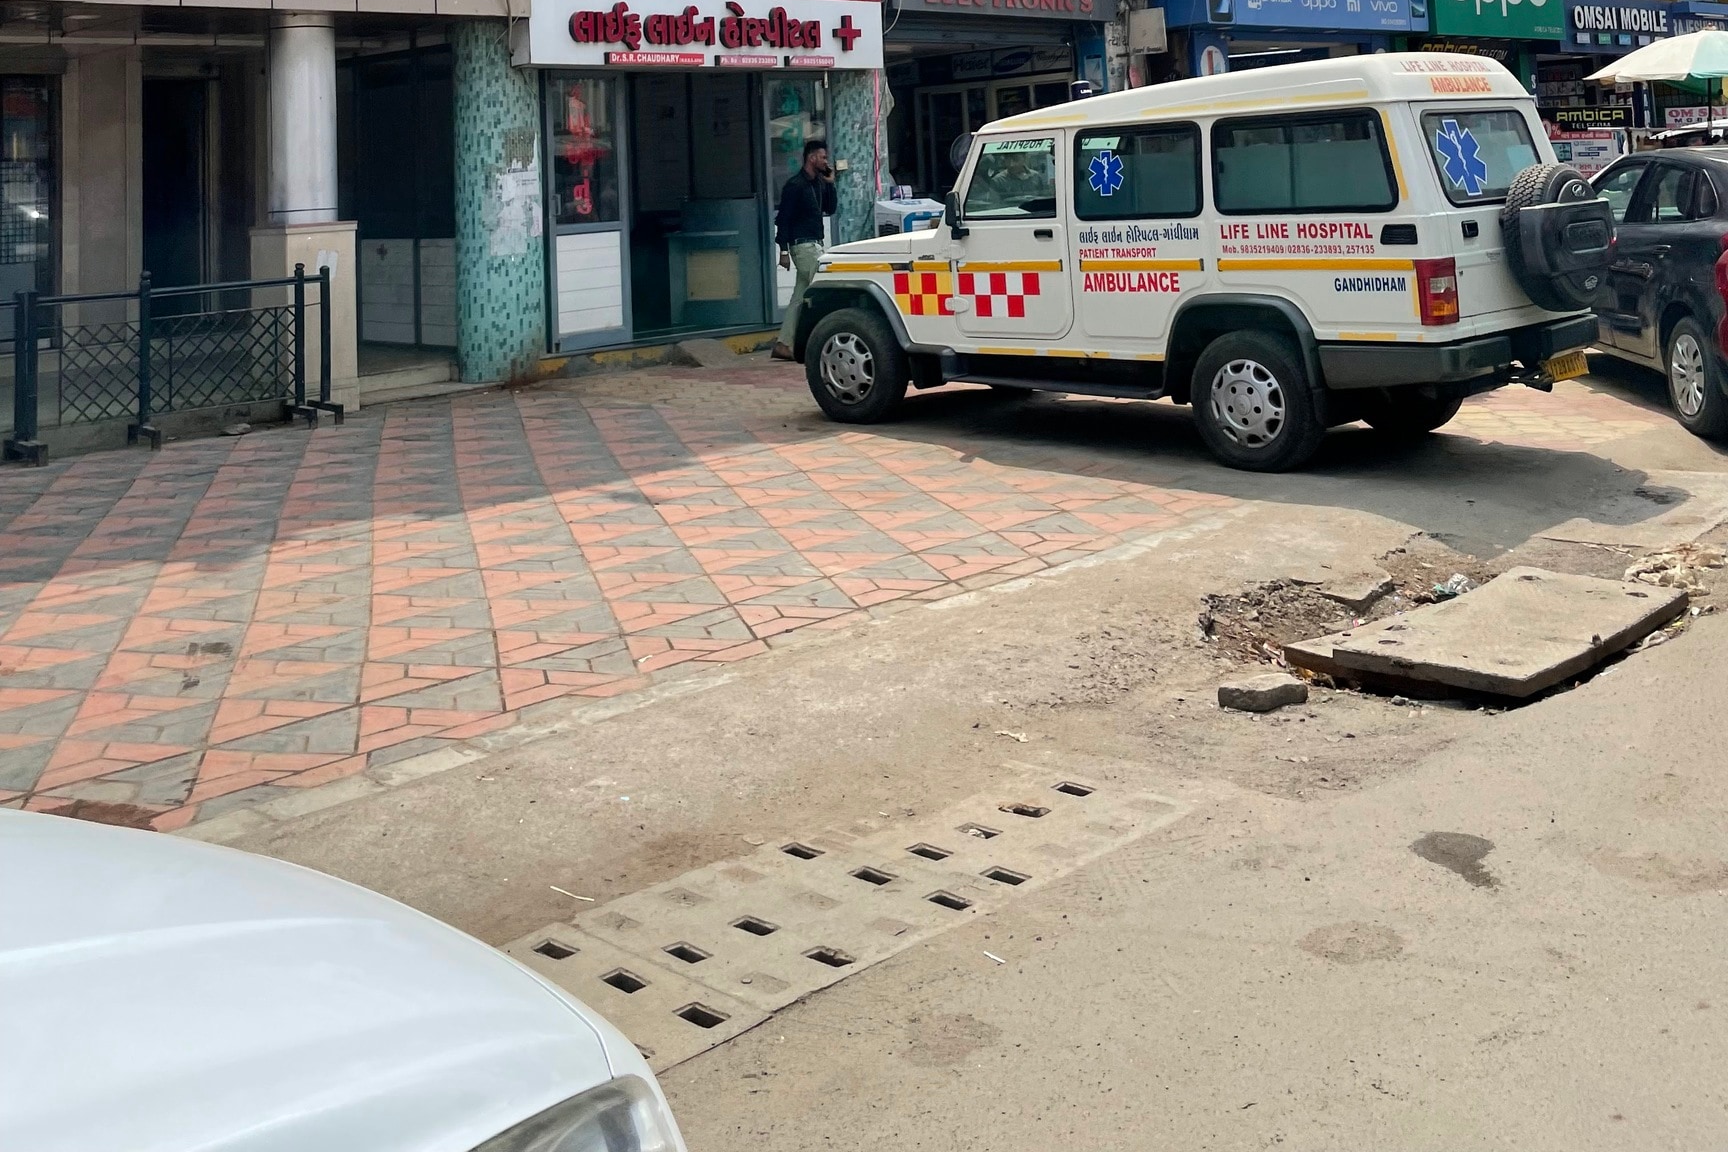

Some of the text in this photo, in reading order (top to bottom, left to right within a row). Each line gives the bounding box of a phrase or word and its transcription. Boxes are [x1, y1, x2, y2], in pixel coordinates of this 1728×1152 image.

[1573, 4, 1669, 33] OMSAI MOBILE
[637, 53, 680, 63] CHAUDHARY
[1400, 60, 1491, 73] LIFE LINE HOSPITAL
[1430, 76, 1492, 93] AMBULANCE
[1220, 223, 1374, 240] LIFE LINE HOSPITAL
[1079, 247, 1157, 259] PATIENT TRANSPORT
[1083, 272, 1180, 293] AMBULANCE
[1334, 277, 1407, 292] GANDHIDHAM
